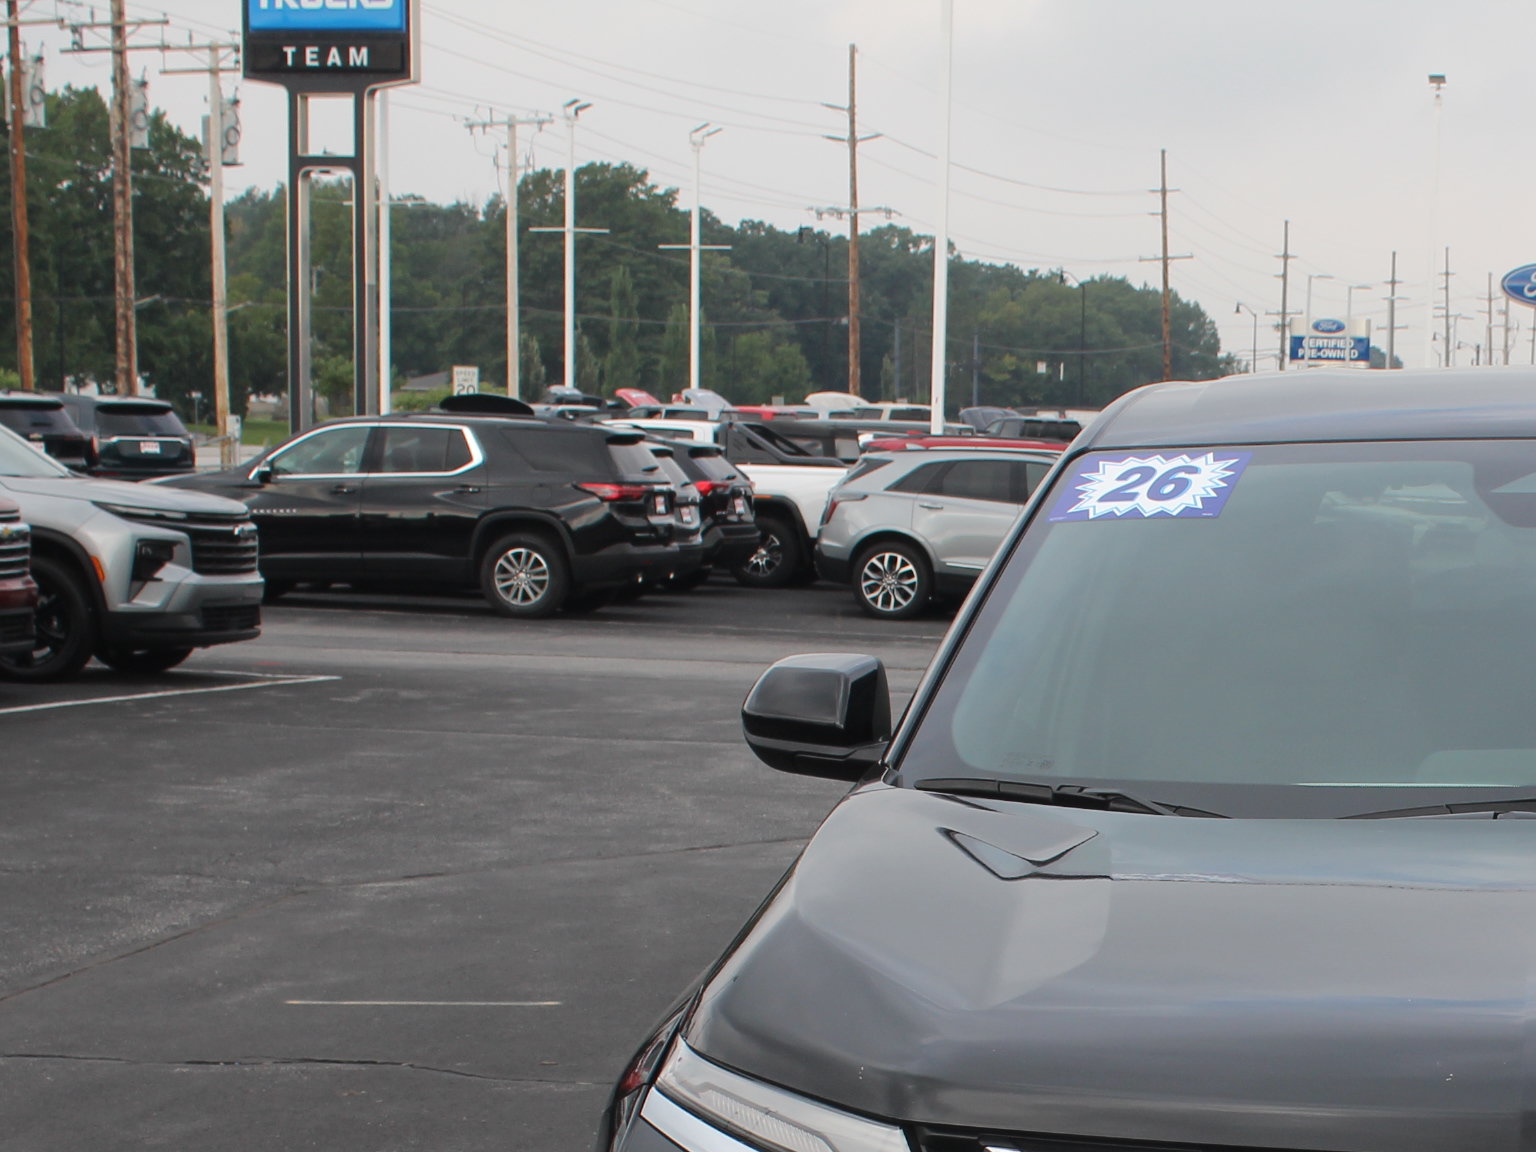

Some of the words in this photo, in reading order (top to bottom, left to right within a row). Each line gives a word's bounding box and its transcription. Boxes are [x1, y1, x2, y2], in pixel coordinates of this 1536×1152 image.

[282, 45, 369, 67] TEAM
[1298, 349, 1359, 359] PE-OWND
[1097, 465, 1202, 503] 26
